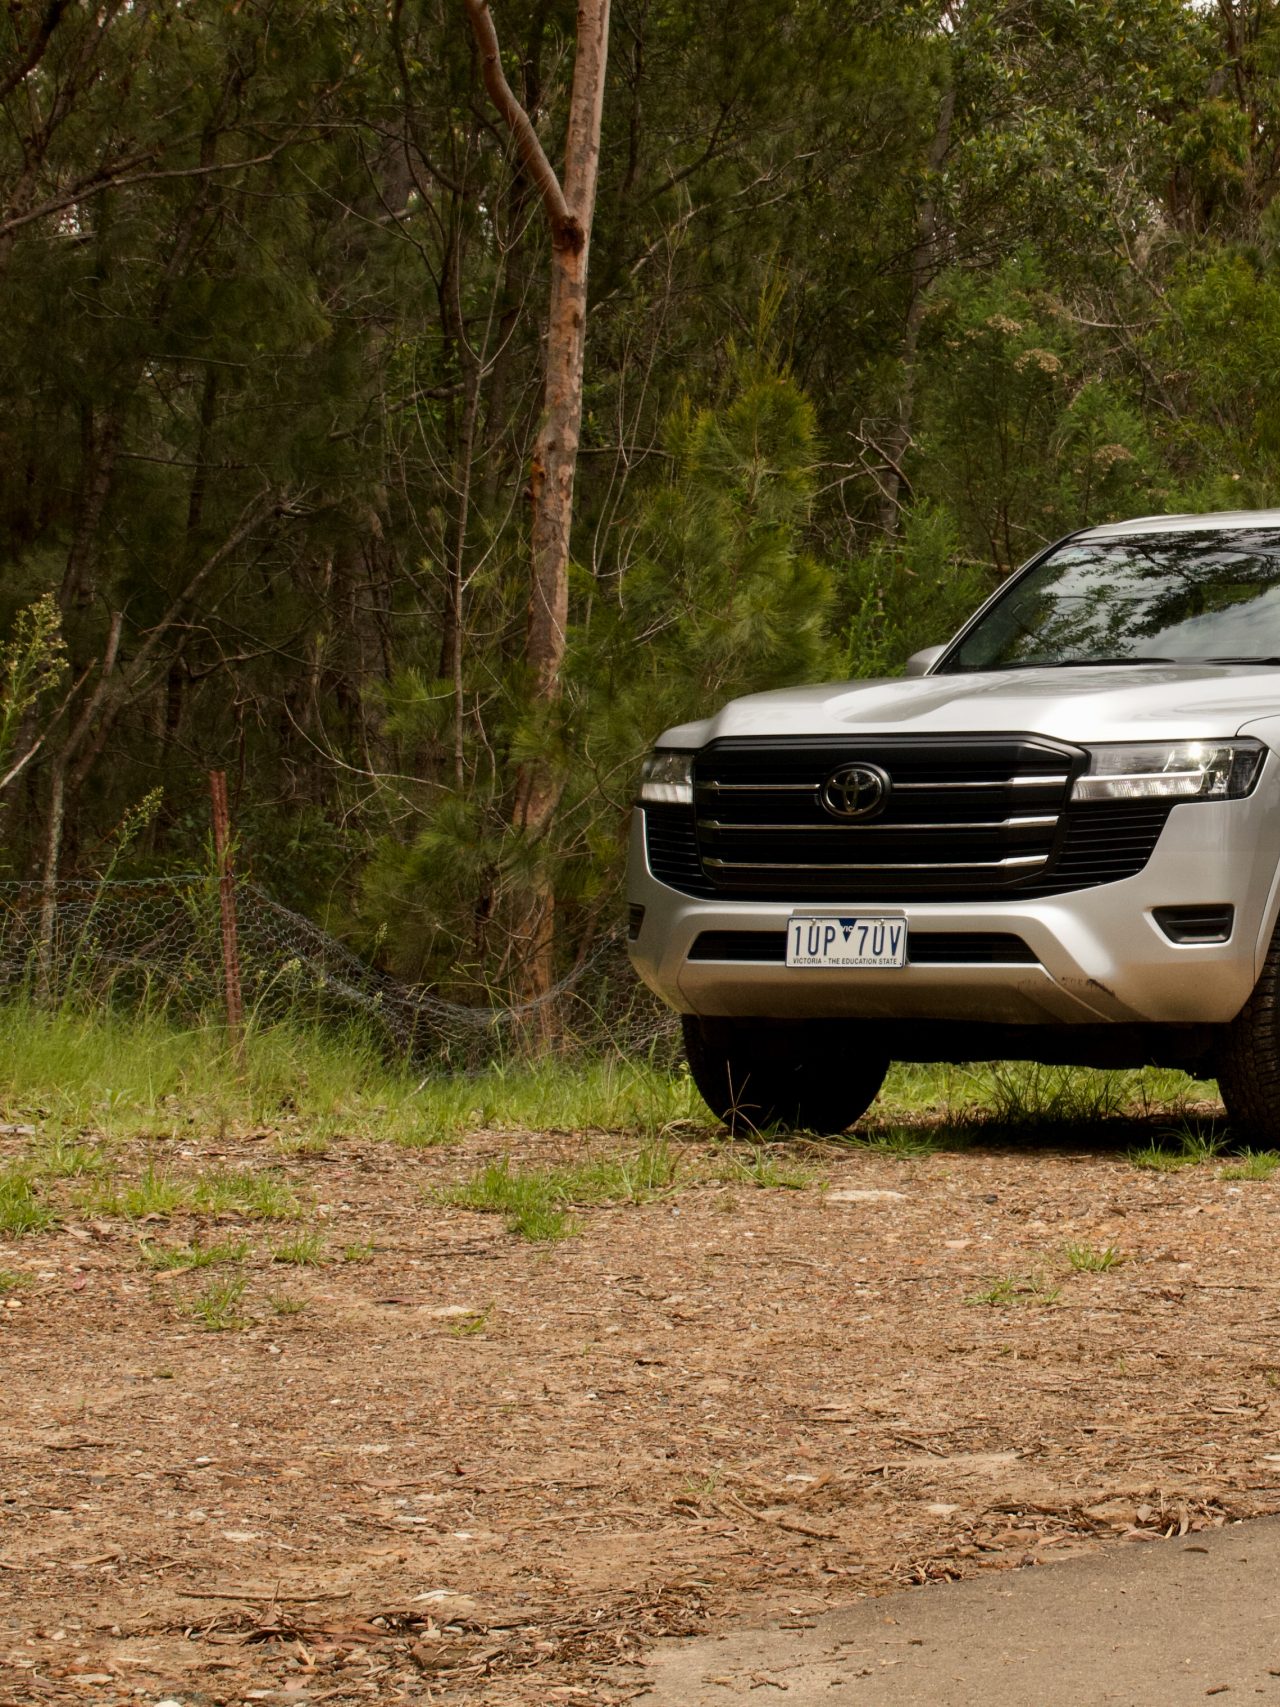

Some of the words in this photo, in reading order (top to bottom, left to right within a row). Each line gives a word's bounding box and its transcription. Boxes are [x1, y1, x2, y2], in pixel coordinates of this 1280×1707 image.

[795, 926, 836, 956] 1UP
[857, 926, 901, 956] 7UV
[793, 957, 822, 965] VICTORIA
[828, 957, 840, 965] THE
[841, 957, 877, 965] EDUCATION
[879, 957, 897, 965] STATE
